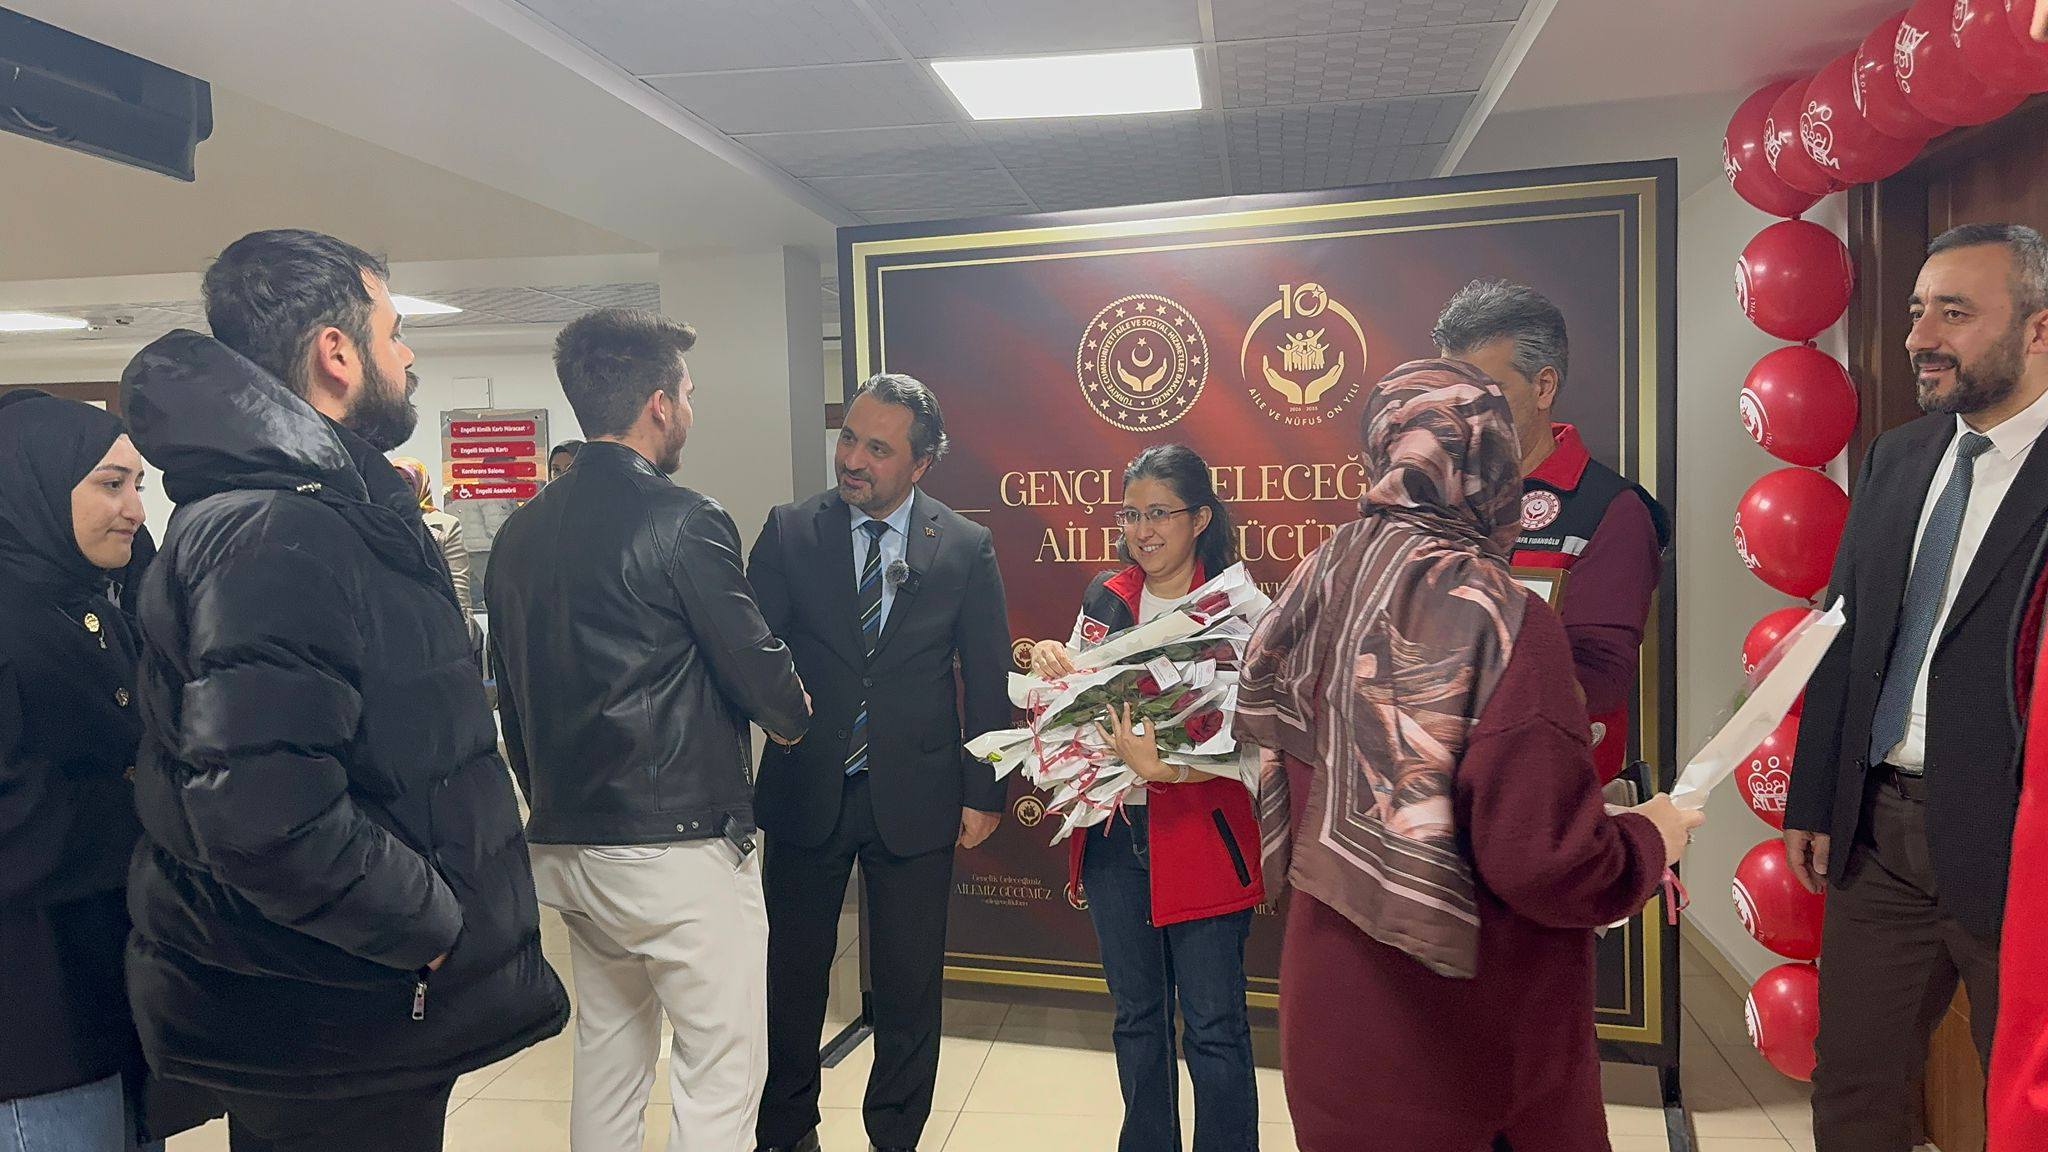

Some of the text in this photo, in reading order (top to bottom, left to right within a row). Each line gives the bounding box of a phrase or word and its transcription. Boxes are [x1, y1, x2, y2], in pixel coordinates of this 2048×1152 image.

[1279, 282, 1328, 319] 10
[1100, 318, 1185, 406] TÜRKİYE CUMHURİYETİ AİLE VE SOSYAL HİZMETLER BAKANLIĞI
[1248, 382, 1361, 426] AİLE VE NÜFUS ON YILI
[1000, 454, 1368, 514] GENÇL ELECEĞ
[1035, 519, 1338, 563] AİLE ÜCÜ
